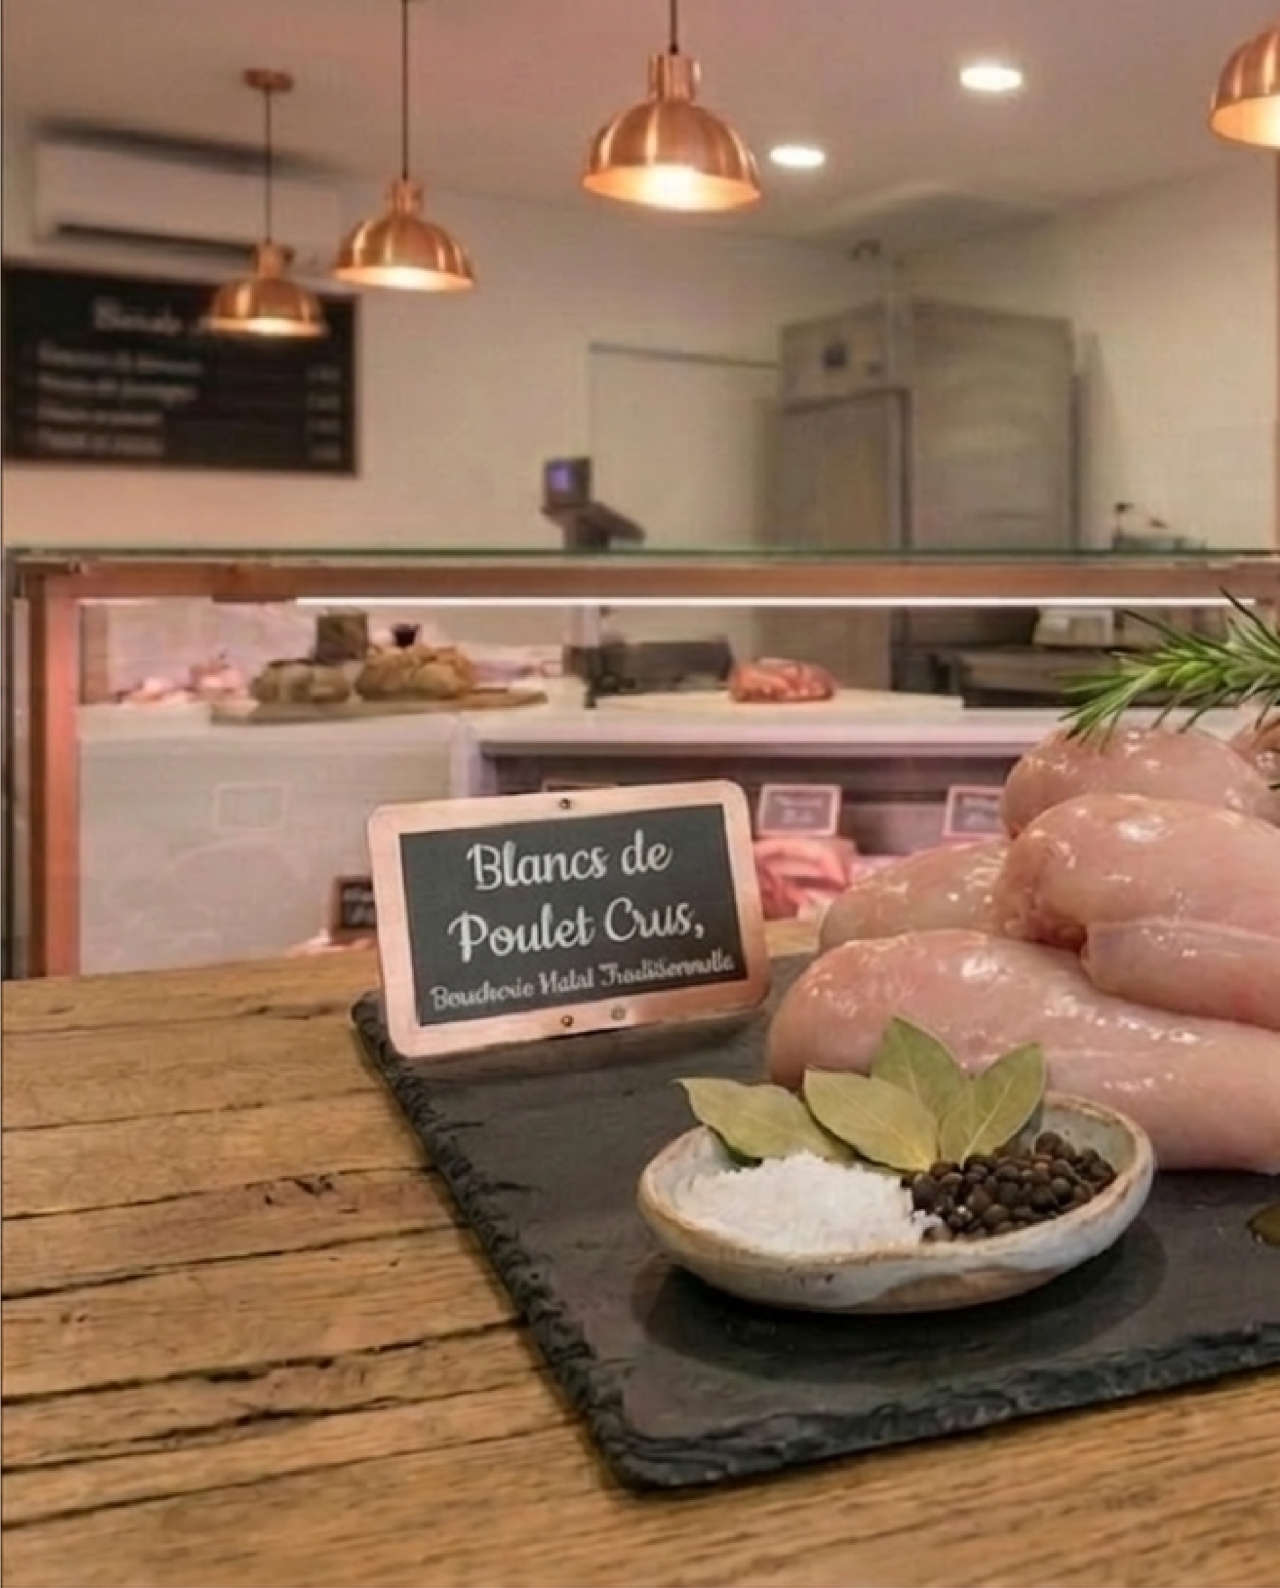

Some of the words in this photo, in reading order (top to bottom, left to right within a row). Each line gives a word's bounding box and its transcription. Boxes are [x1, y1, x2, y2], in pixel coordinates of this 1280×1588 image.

[465, 840, 609, 891] Blancs
[621, 829, 673, 876] de
[447, 903, 597, 963] Poulet
[604, 897, 705, 941] Crus,
